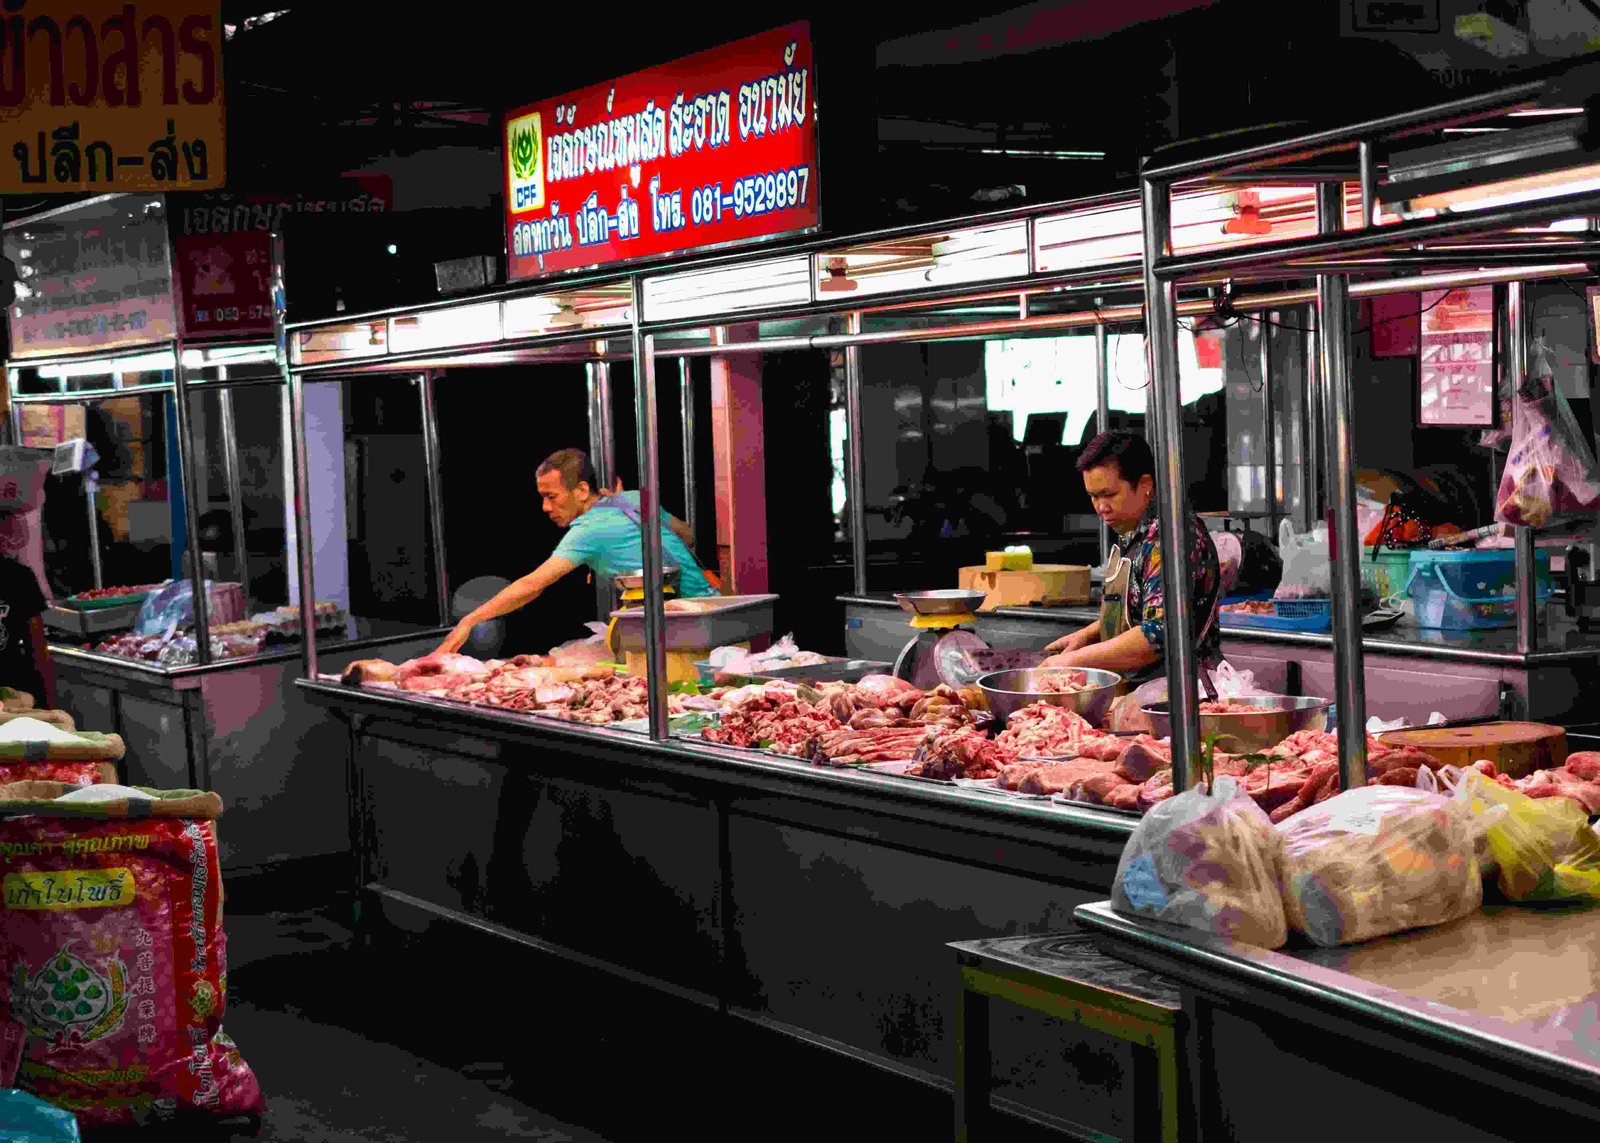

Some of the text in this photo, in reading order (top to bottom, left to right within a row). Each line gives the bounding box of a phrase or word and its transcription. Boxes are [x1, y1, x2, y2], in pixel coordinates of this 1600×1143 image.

[669, 93, 731, 156] สะอาด
[738, 42, 808, 140] อนามัย
[13, 118, 207, 182] ปลีก-ส่ง
[513, 166, 810, 270] สดทุกวัน ปลีก-ส่ง โทร. 081-9529897
[516, 183, 537, 208] CPF
[8, 869, 127, 906] เก้าใบโพธิ์
